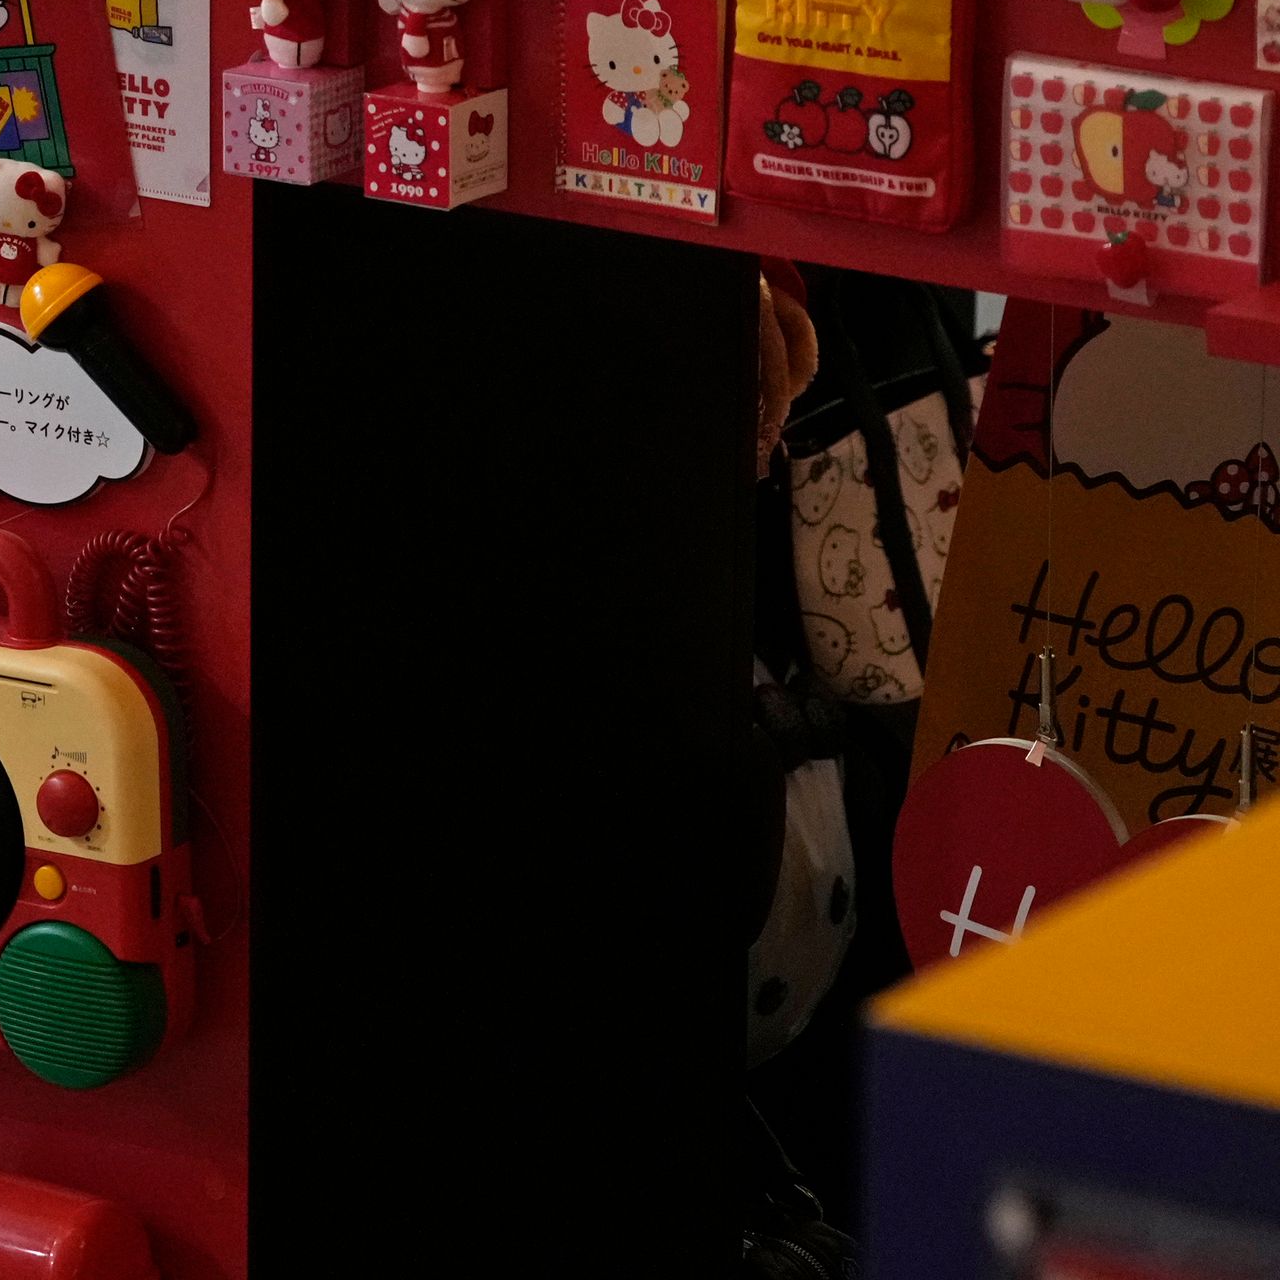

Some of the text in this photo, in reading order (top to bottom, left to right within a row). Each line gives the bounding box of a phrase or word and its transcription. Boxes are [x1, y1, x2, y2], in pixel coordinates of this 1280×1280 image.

[142, 134, 166, 143] PLACE
[582, 142, 703, 181] Hello Kitty
[247, 163, 281, 178] 1997
[761, 159, 928, 193] SHARING FRIENDSHIP FUN!
[390, 183, 423, 197] 1990
[1096, 206, 1131, 218] HELLO
[13, 238, 32, 252] KITTY
[1011, 559, 1280, 705] Hello
[1009, 653, 1233, 826] Kitty
